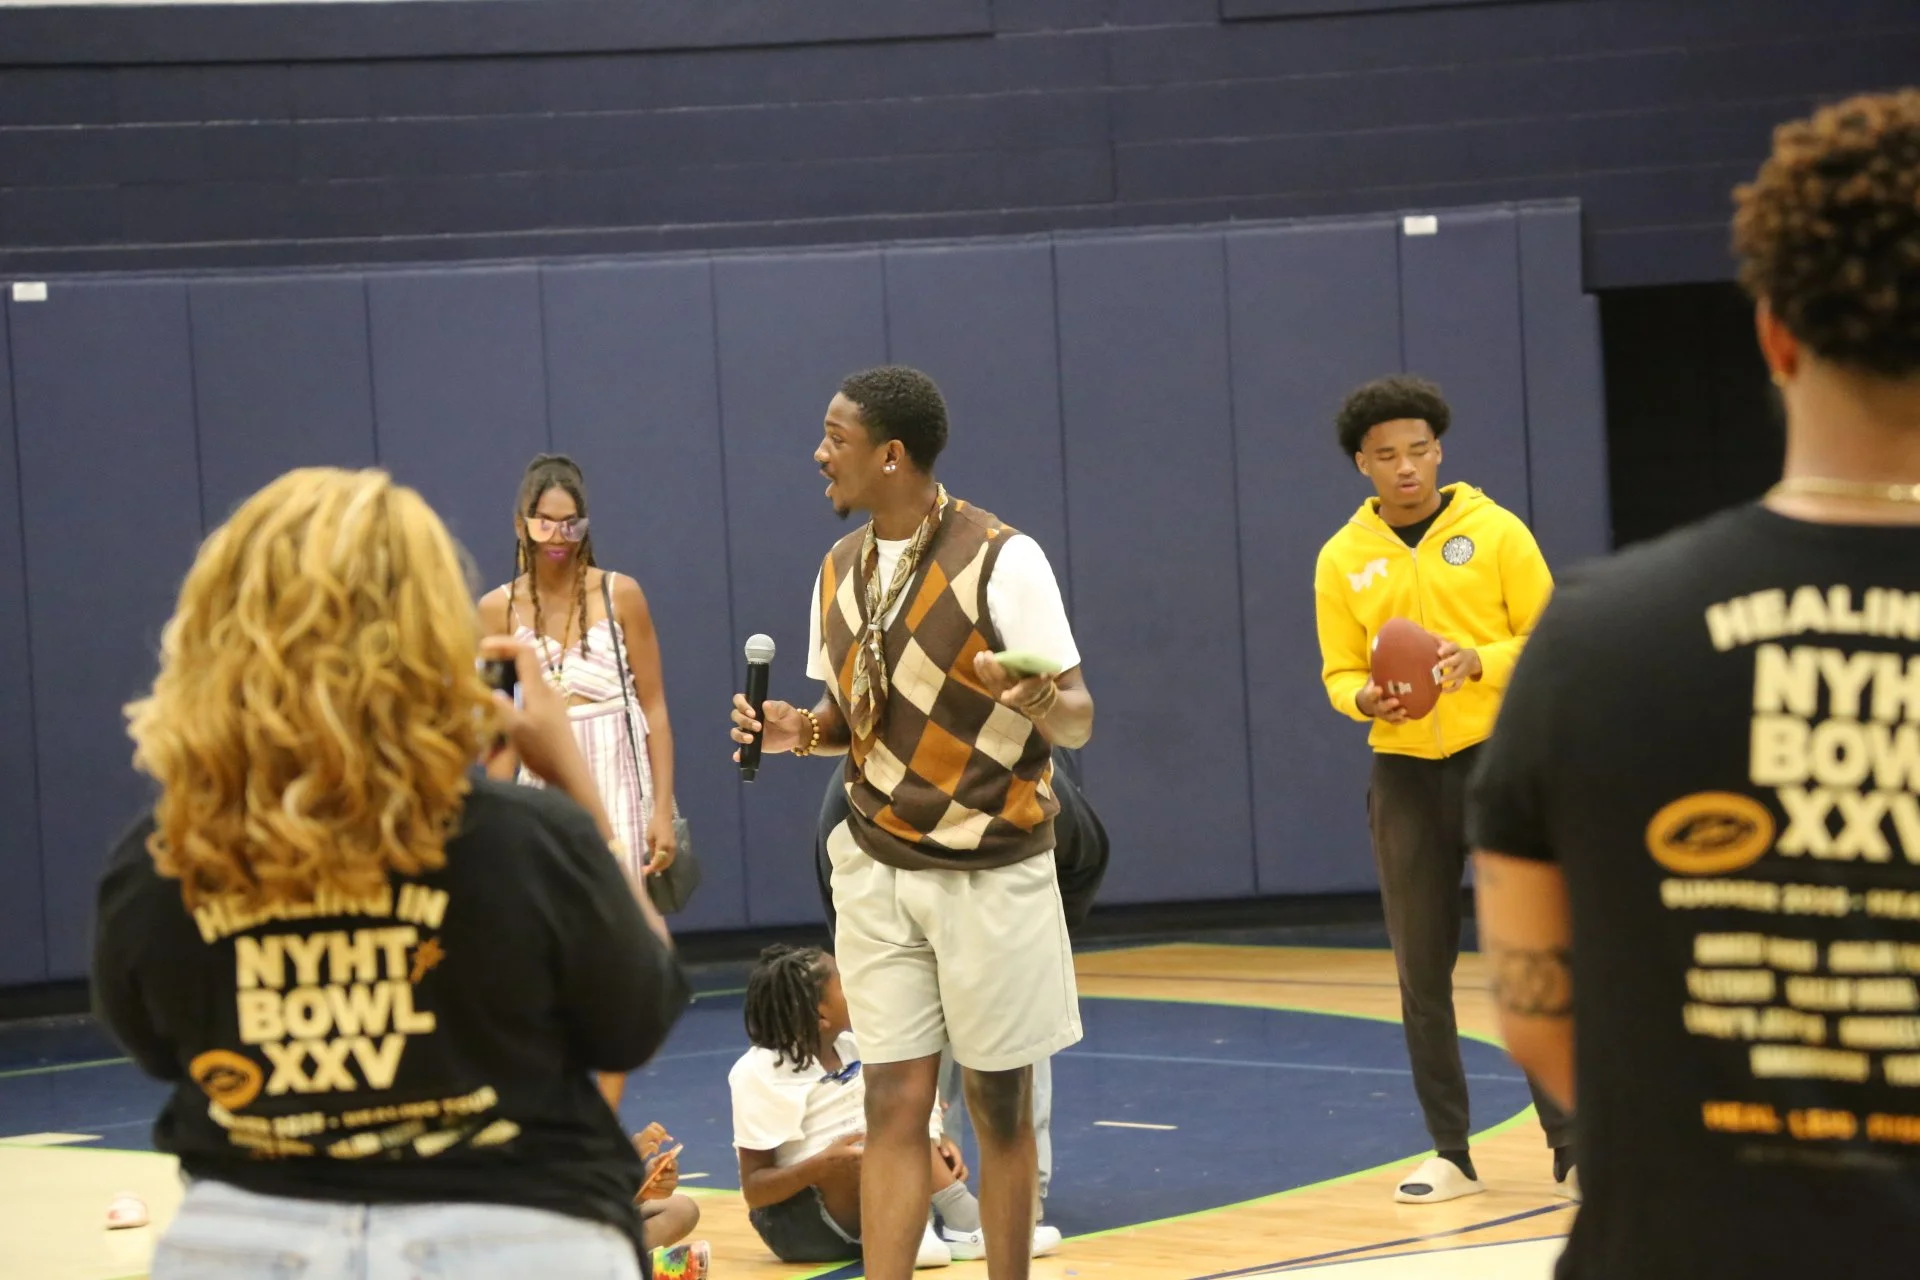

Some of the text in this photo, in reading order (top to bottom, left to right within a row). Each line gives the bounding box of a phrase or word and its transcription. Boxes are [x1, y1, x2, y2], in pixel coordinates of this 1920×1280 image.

[397, 882, 448, 928] IN
[236, 926, 418, 989] NYHT
[236, 980, 436, 1044] BOWL
[260, 1033, 406, 1096] XXV
